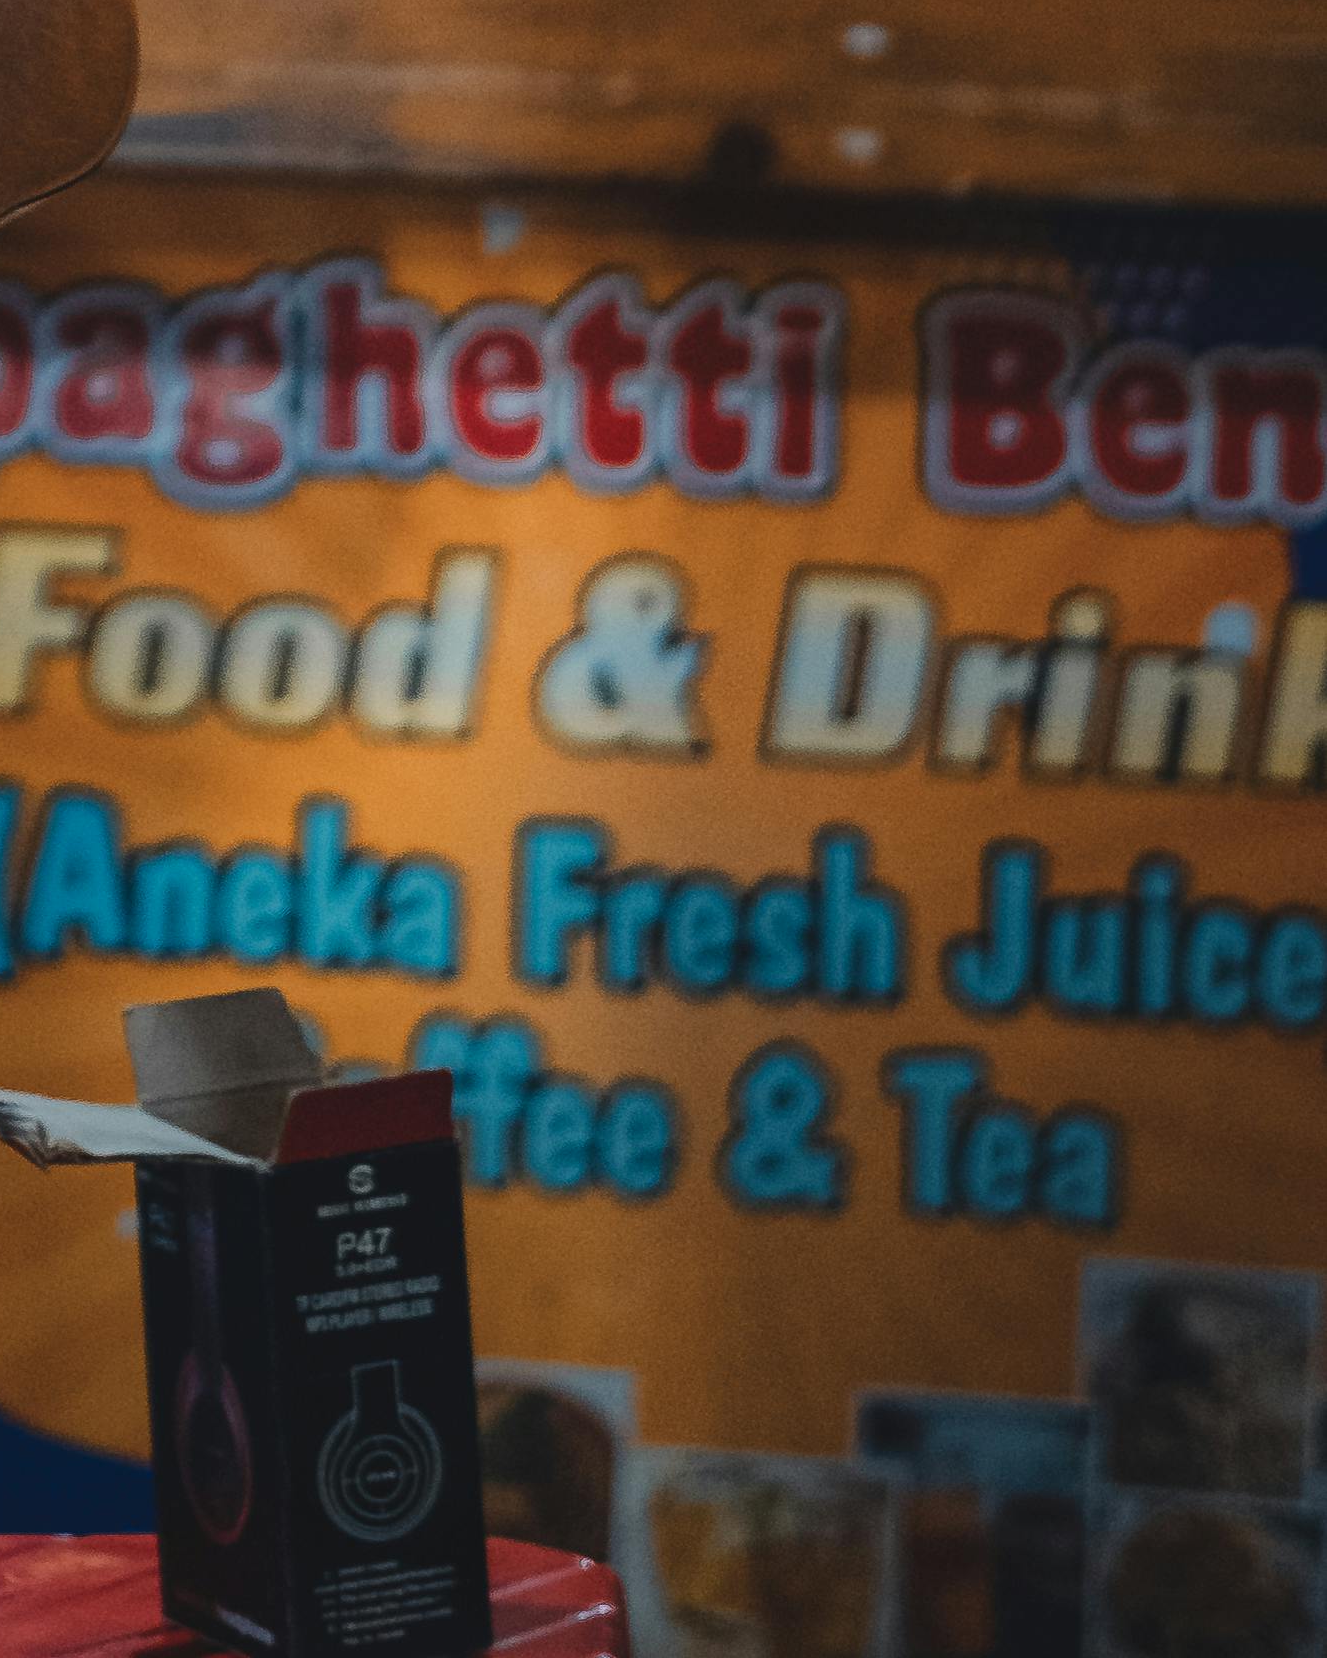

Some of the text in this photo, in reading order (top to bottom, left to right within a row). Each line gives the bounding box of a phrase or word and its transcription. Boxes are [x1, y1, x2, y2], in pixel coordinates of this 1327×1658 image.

[537, 551, 712, 757] &
[513, 815, 903, 1007] Fresh
[719, 1040, 849, 1215] &
[881, 1046, 1125, 1233] Tea
[335, 1226, 394, 1261] P47
